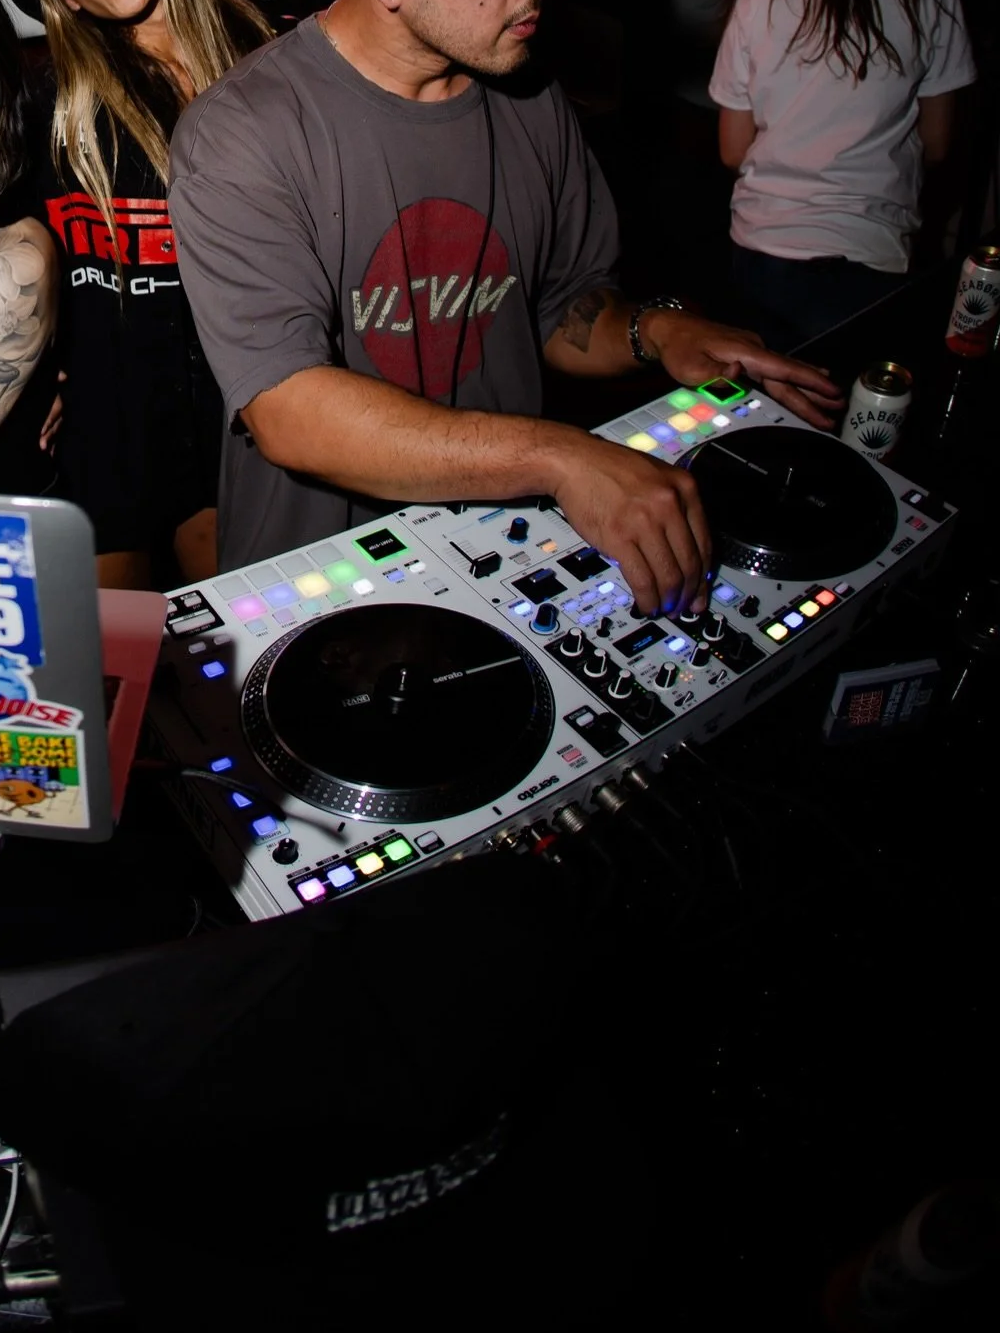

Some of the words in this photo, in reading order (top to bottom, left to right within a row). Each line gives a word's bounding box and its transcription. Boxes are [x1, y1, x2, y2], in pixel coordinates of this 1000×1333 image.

[432, 669, 464, 685] serato
[341, 692, 371, 708] RANE
[18, 735, 75, 748] BAKE
[18, 746, 76, 759] SOME
[516, 774, 560, 802] serato
